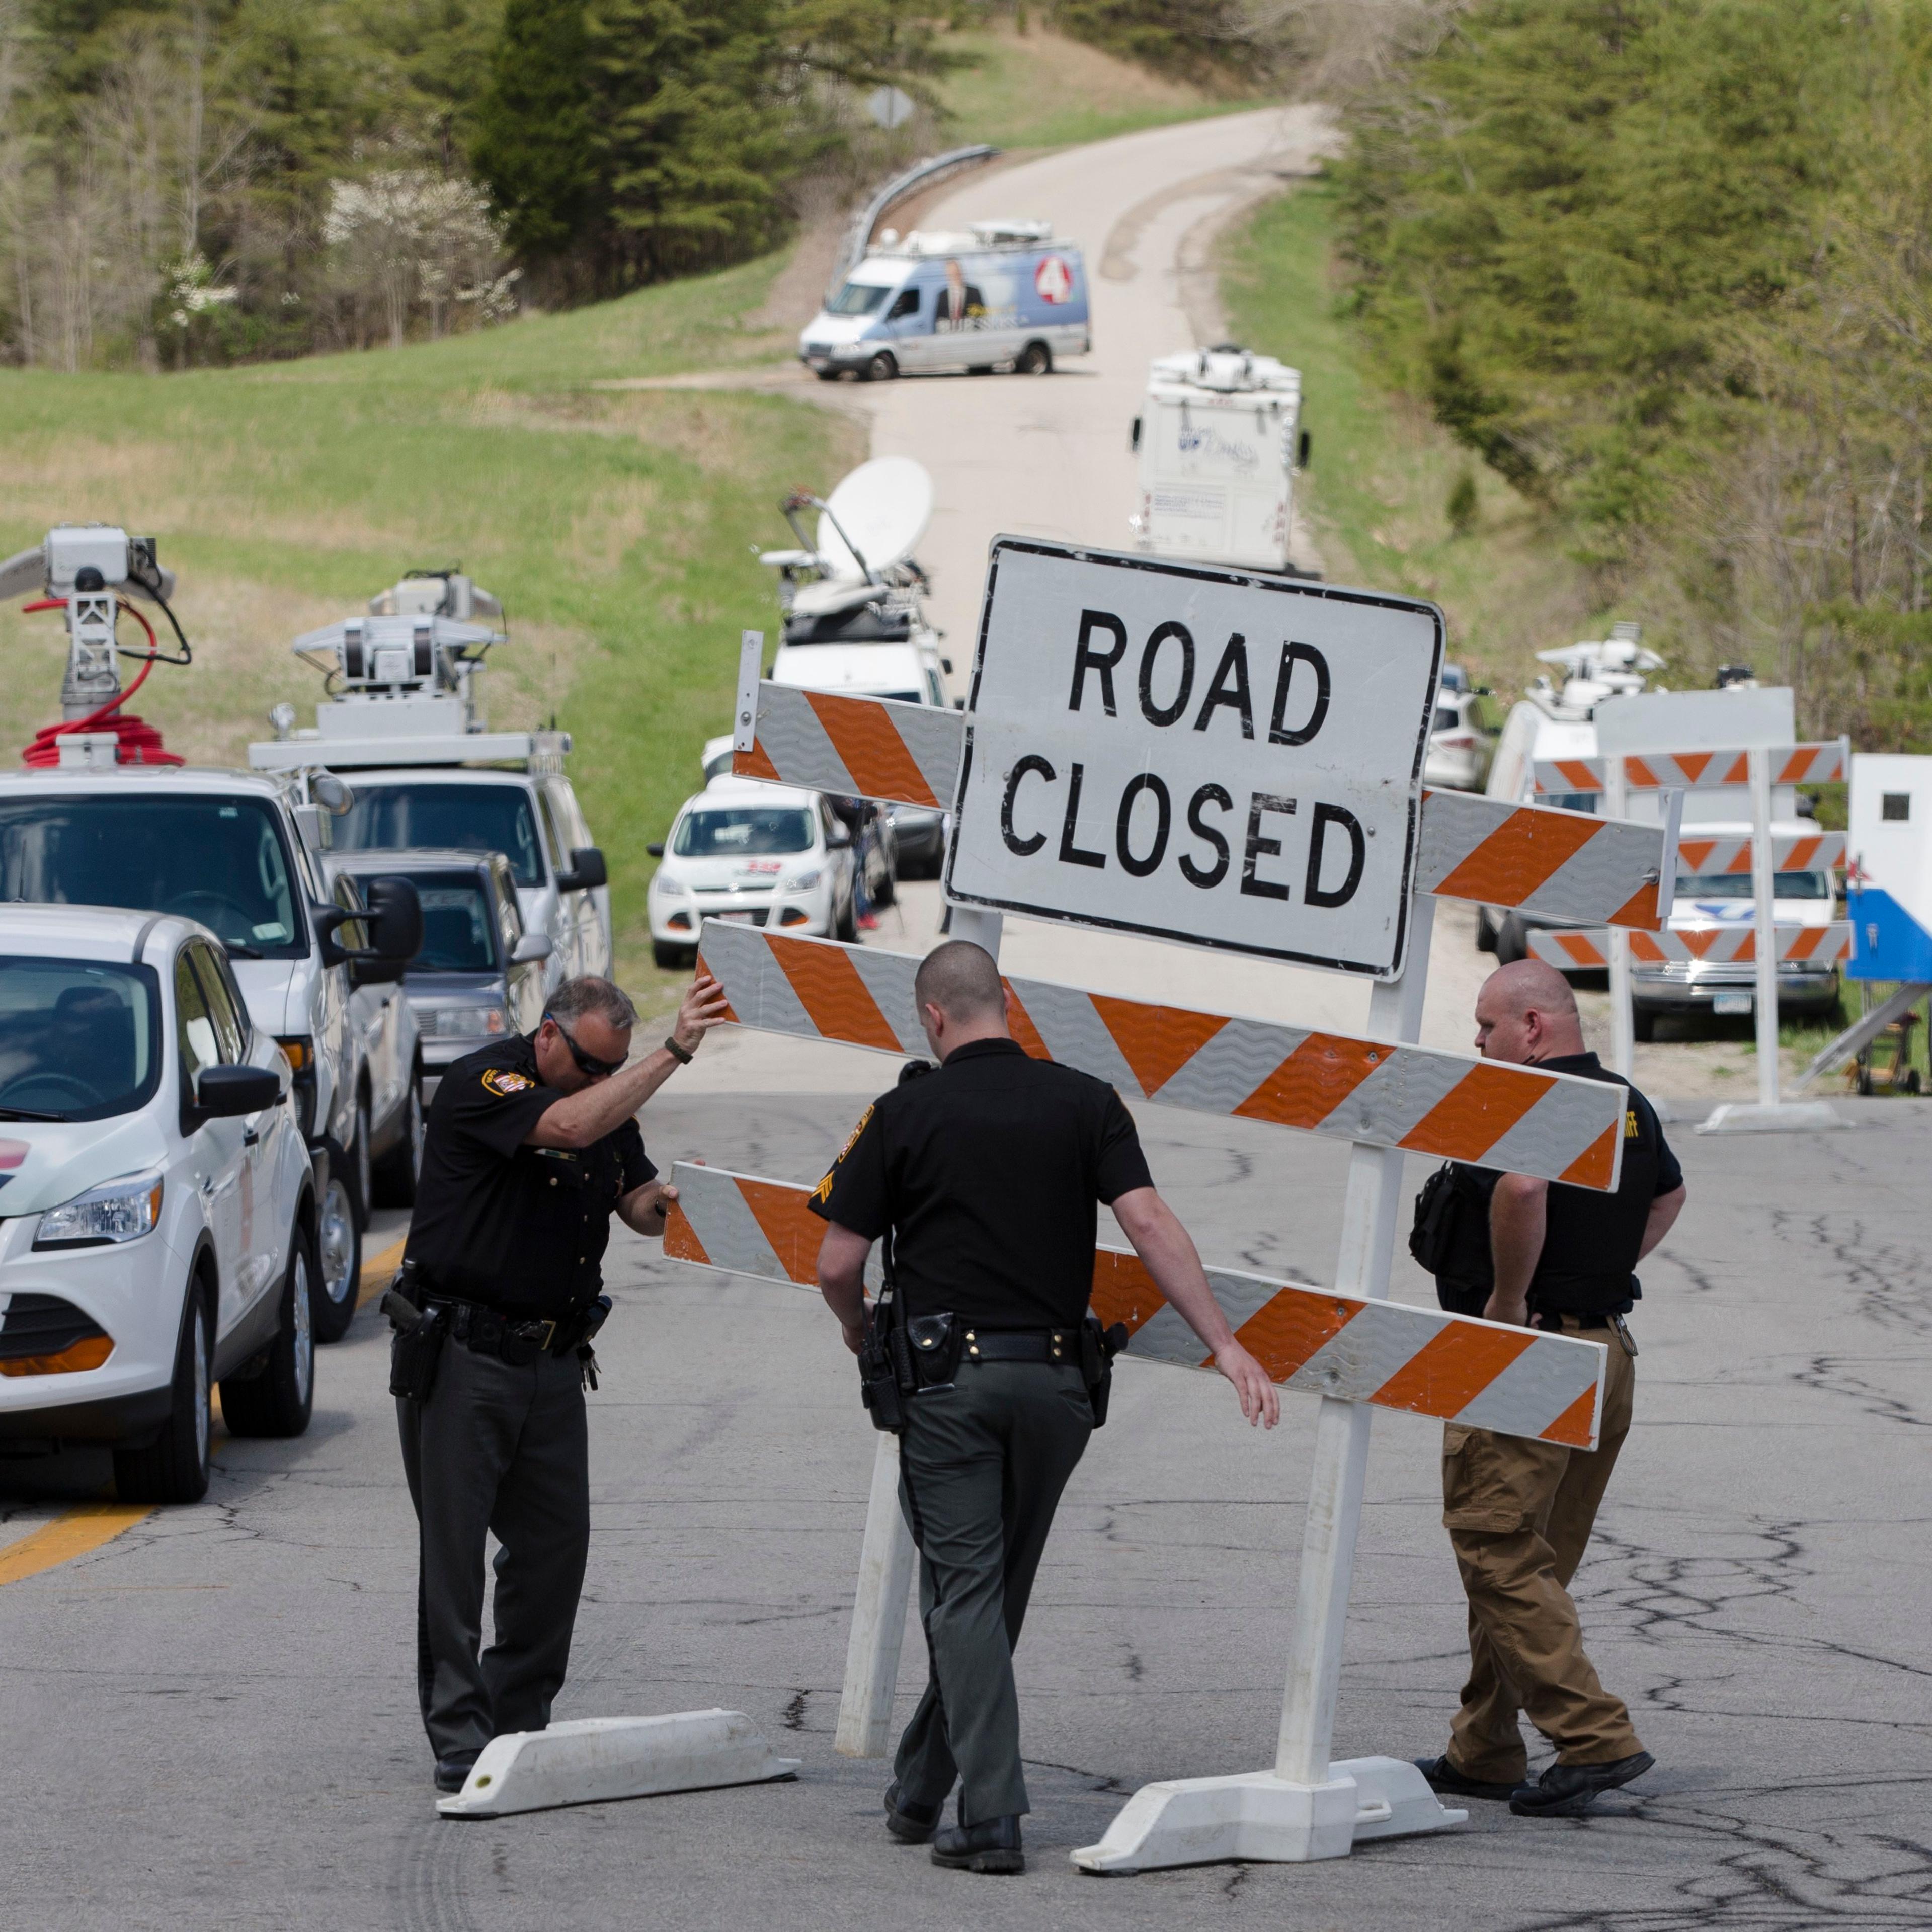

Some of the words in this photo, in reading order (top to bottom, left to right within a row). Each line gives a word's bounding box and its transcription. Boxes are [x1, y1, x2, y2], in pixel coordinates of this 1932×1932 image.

[1036, 256, 1068, 304] 4
[1069, 609, 1331, 747] ROAD
[1000, 754, 1366, 908] CLOSED
